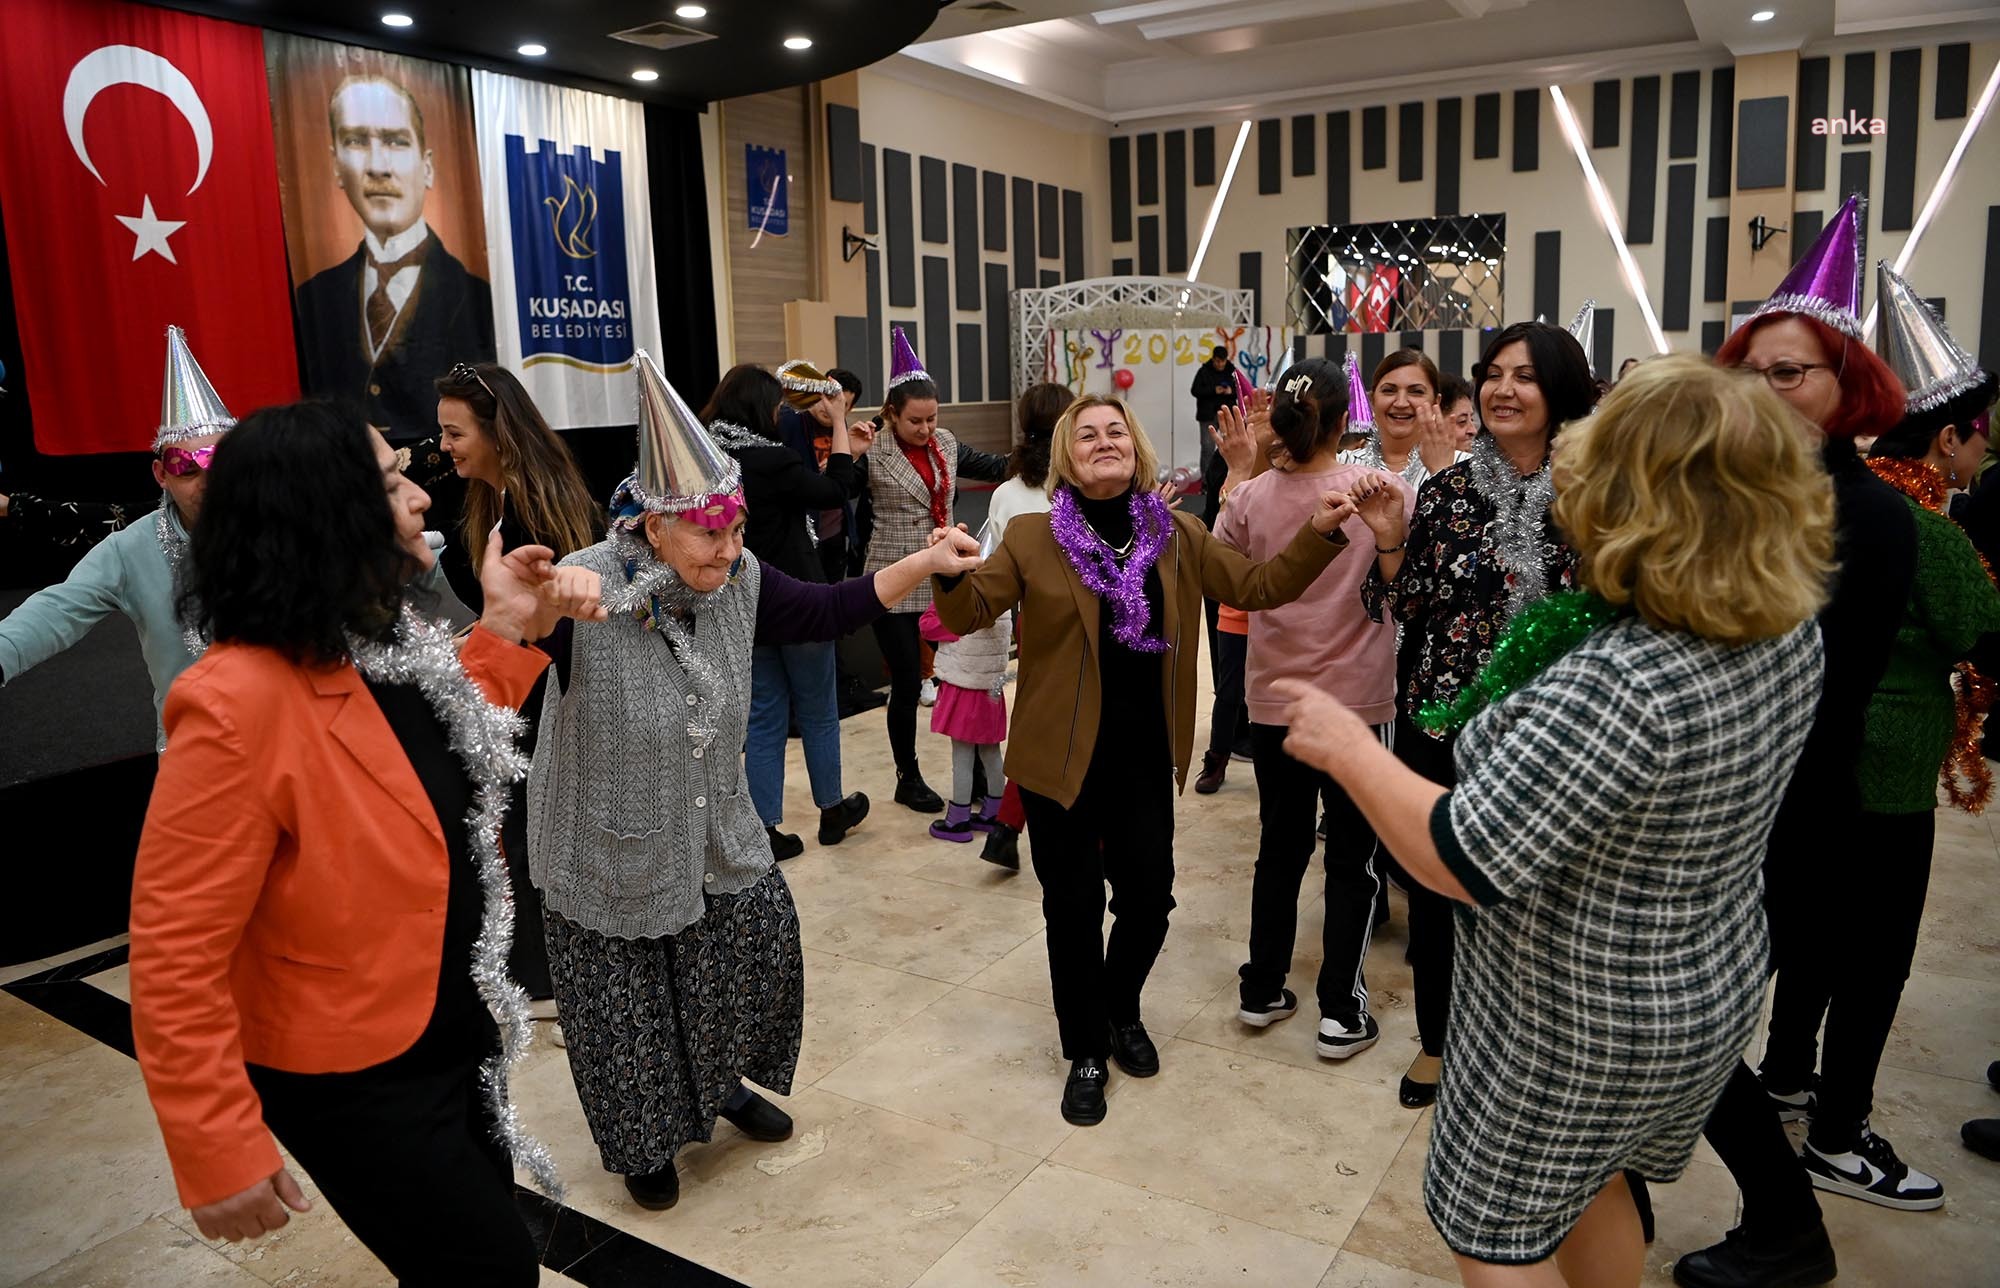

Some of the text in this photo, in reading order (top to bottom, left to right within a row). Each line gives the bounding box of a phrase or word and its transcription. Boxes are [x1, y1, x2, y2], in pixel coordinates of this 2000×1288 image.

[564, 274, 594, 292] T.C.
[529, 296, 625, 320] KUŞADASI
[531, 321, 628, 339] BELEDİYESİ
[1124, 332, 1216, 366] 2025
